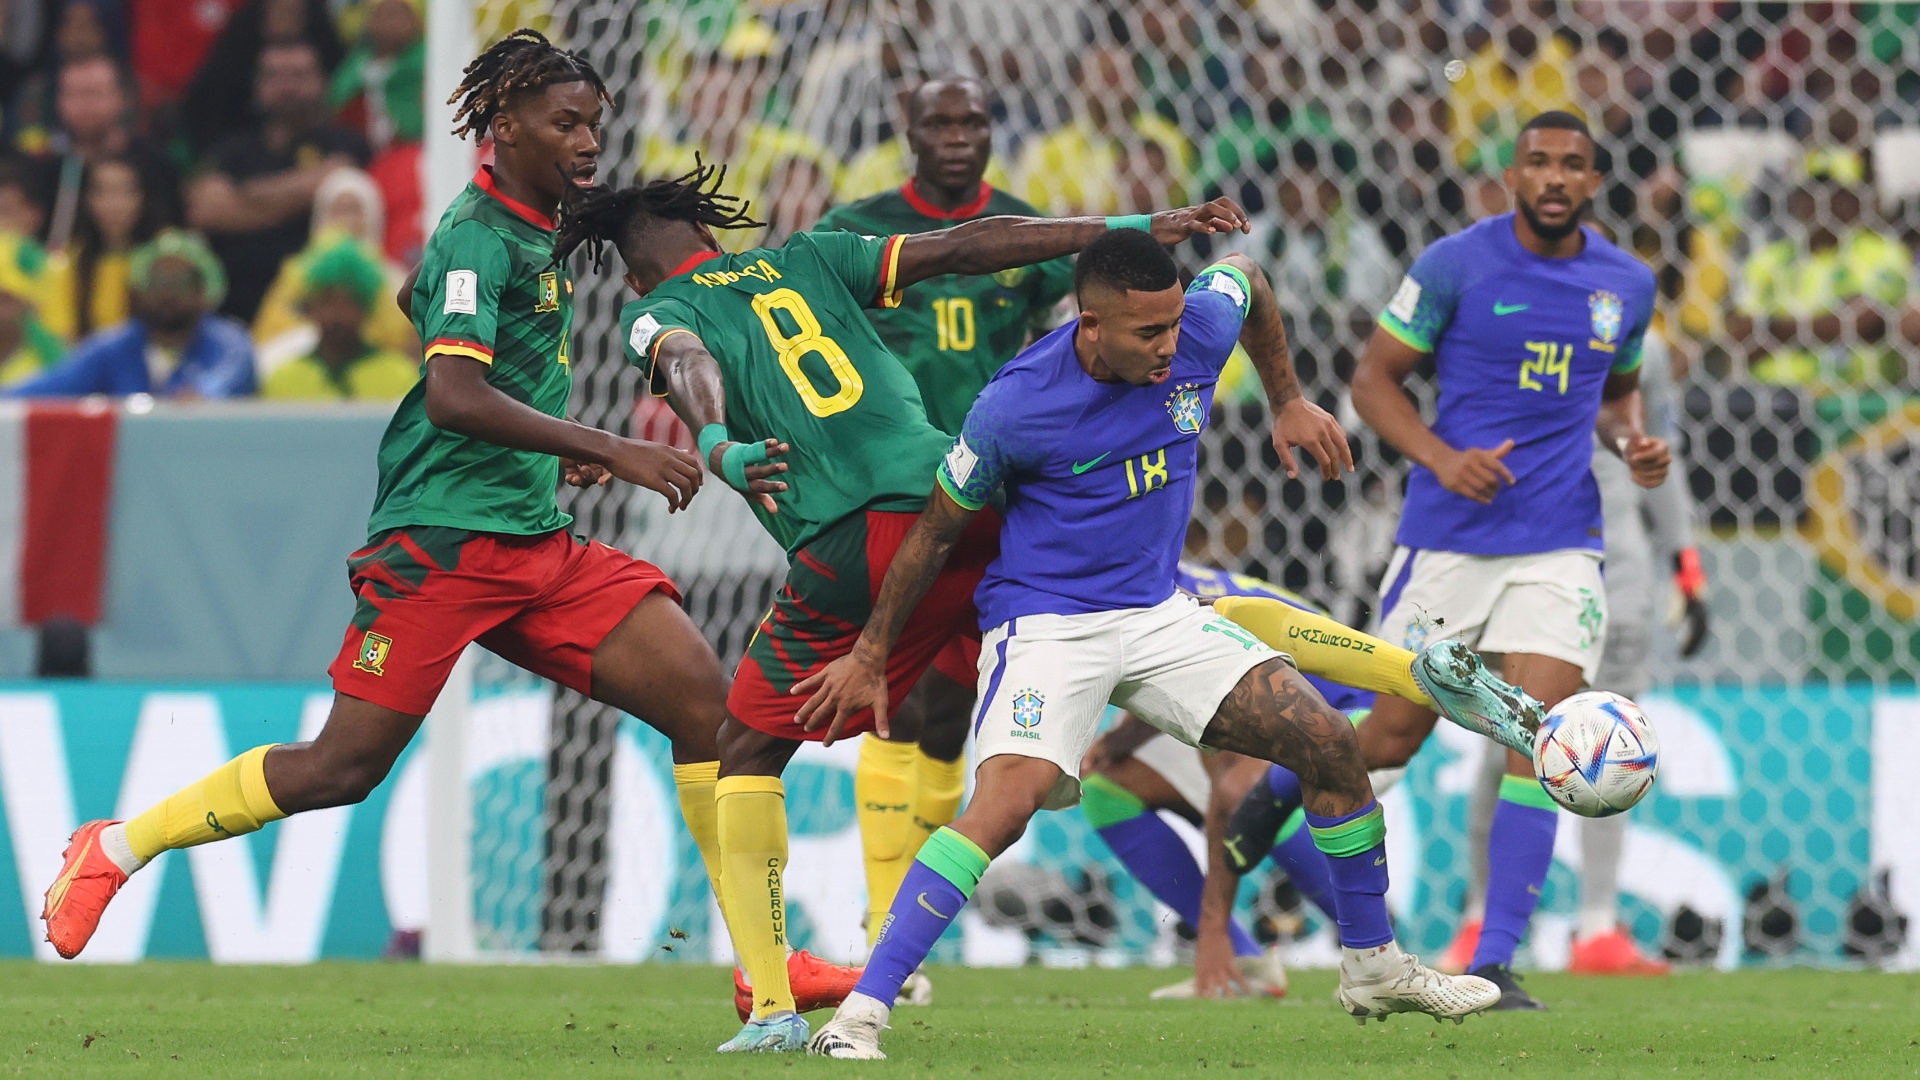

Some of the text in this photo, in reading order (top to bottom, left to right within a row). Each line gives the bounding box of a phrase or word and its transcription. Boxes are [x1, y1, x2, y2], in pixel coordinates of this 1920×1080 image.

[932, 298, 976, 351] 10
[750, 287, 864, 418] 8
[1519, 340, 1574, 395] 24
[1125, 448, 1168, 500] 18
[1288, 625, 1376, 655] CAMEROUN
[1010, 729, 1042, 741] BRASIL
[767, 857, 784, 946] CAMEROUN
